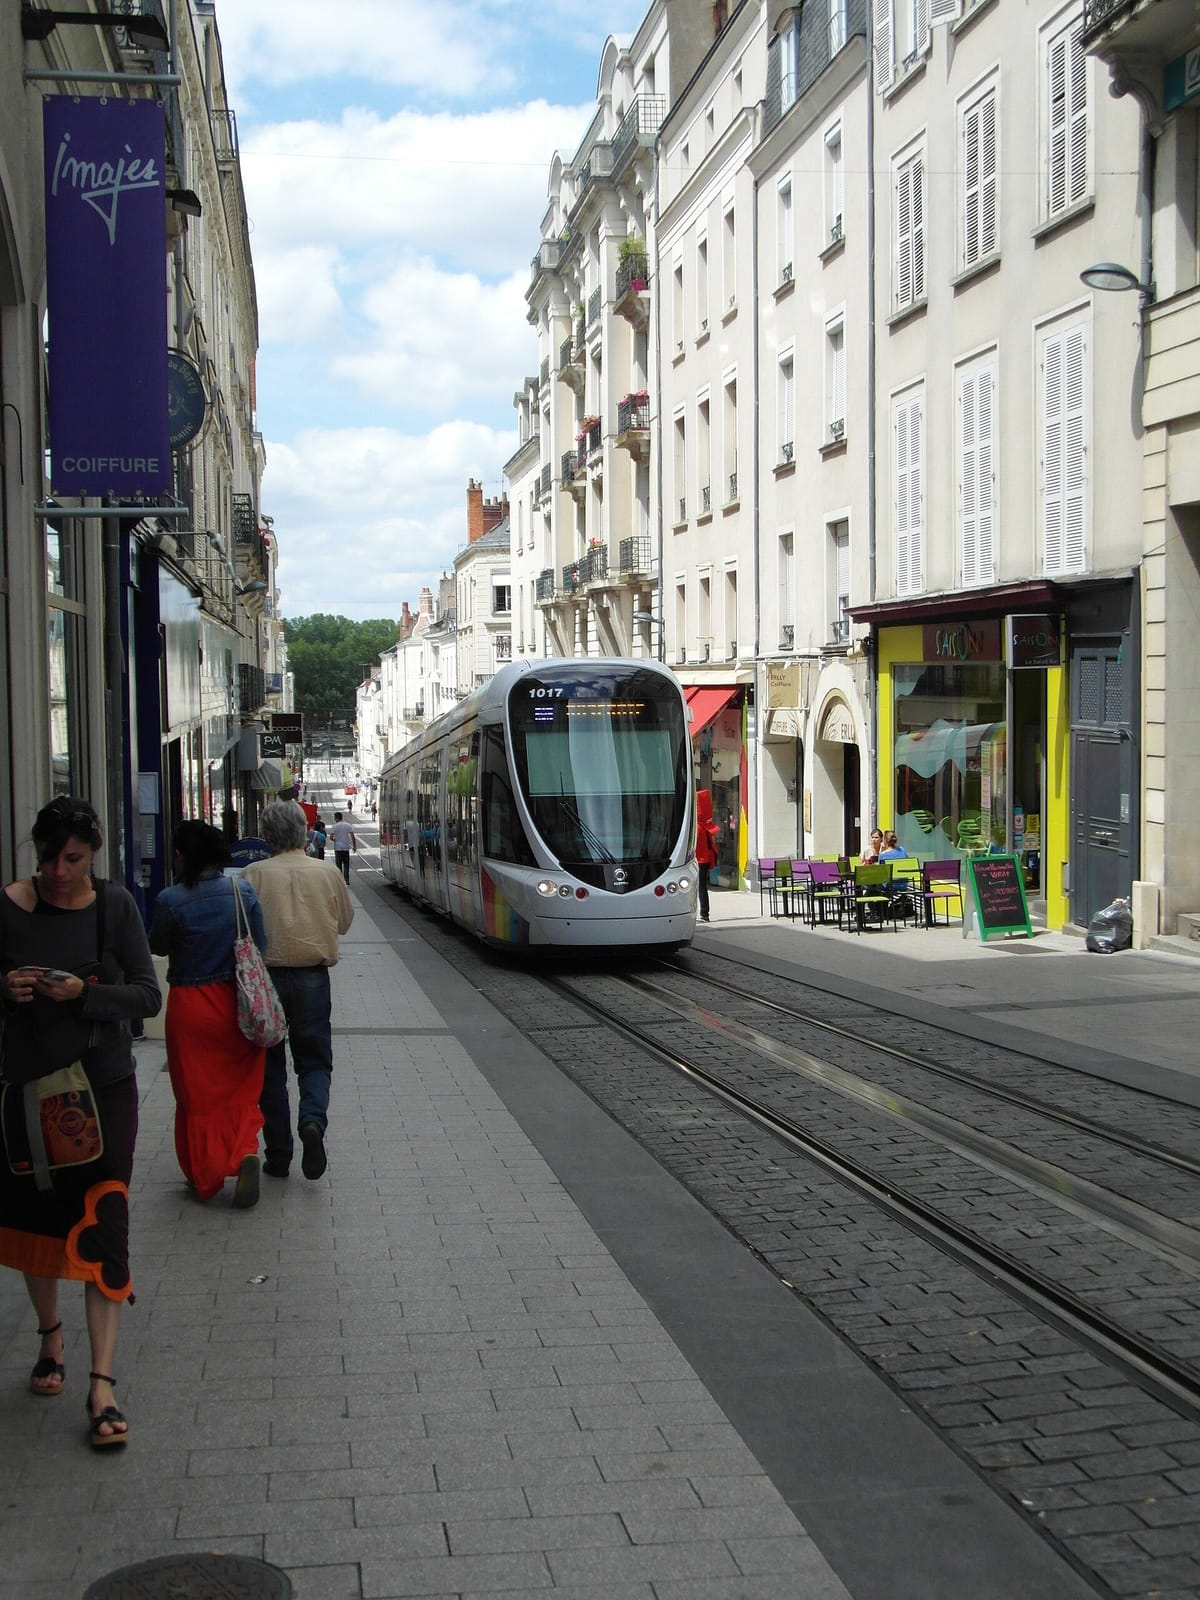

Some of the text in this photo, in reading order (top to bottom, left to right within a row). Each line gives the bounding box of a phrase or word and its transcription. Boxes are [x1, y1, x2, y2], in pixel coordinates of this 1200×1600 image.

[62, 456, 160, 474] COIFFURE
[935, 623, 983, 662] SAISON
[1012, 631, 1059, 648] SAISON
[529, 687, 564, 698] 1017
[263, 735, 282, 745] PM
[841, 723, 855, 741] ERLL
